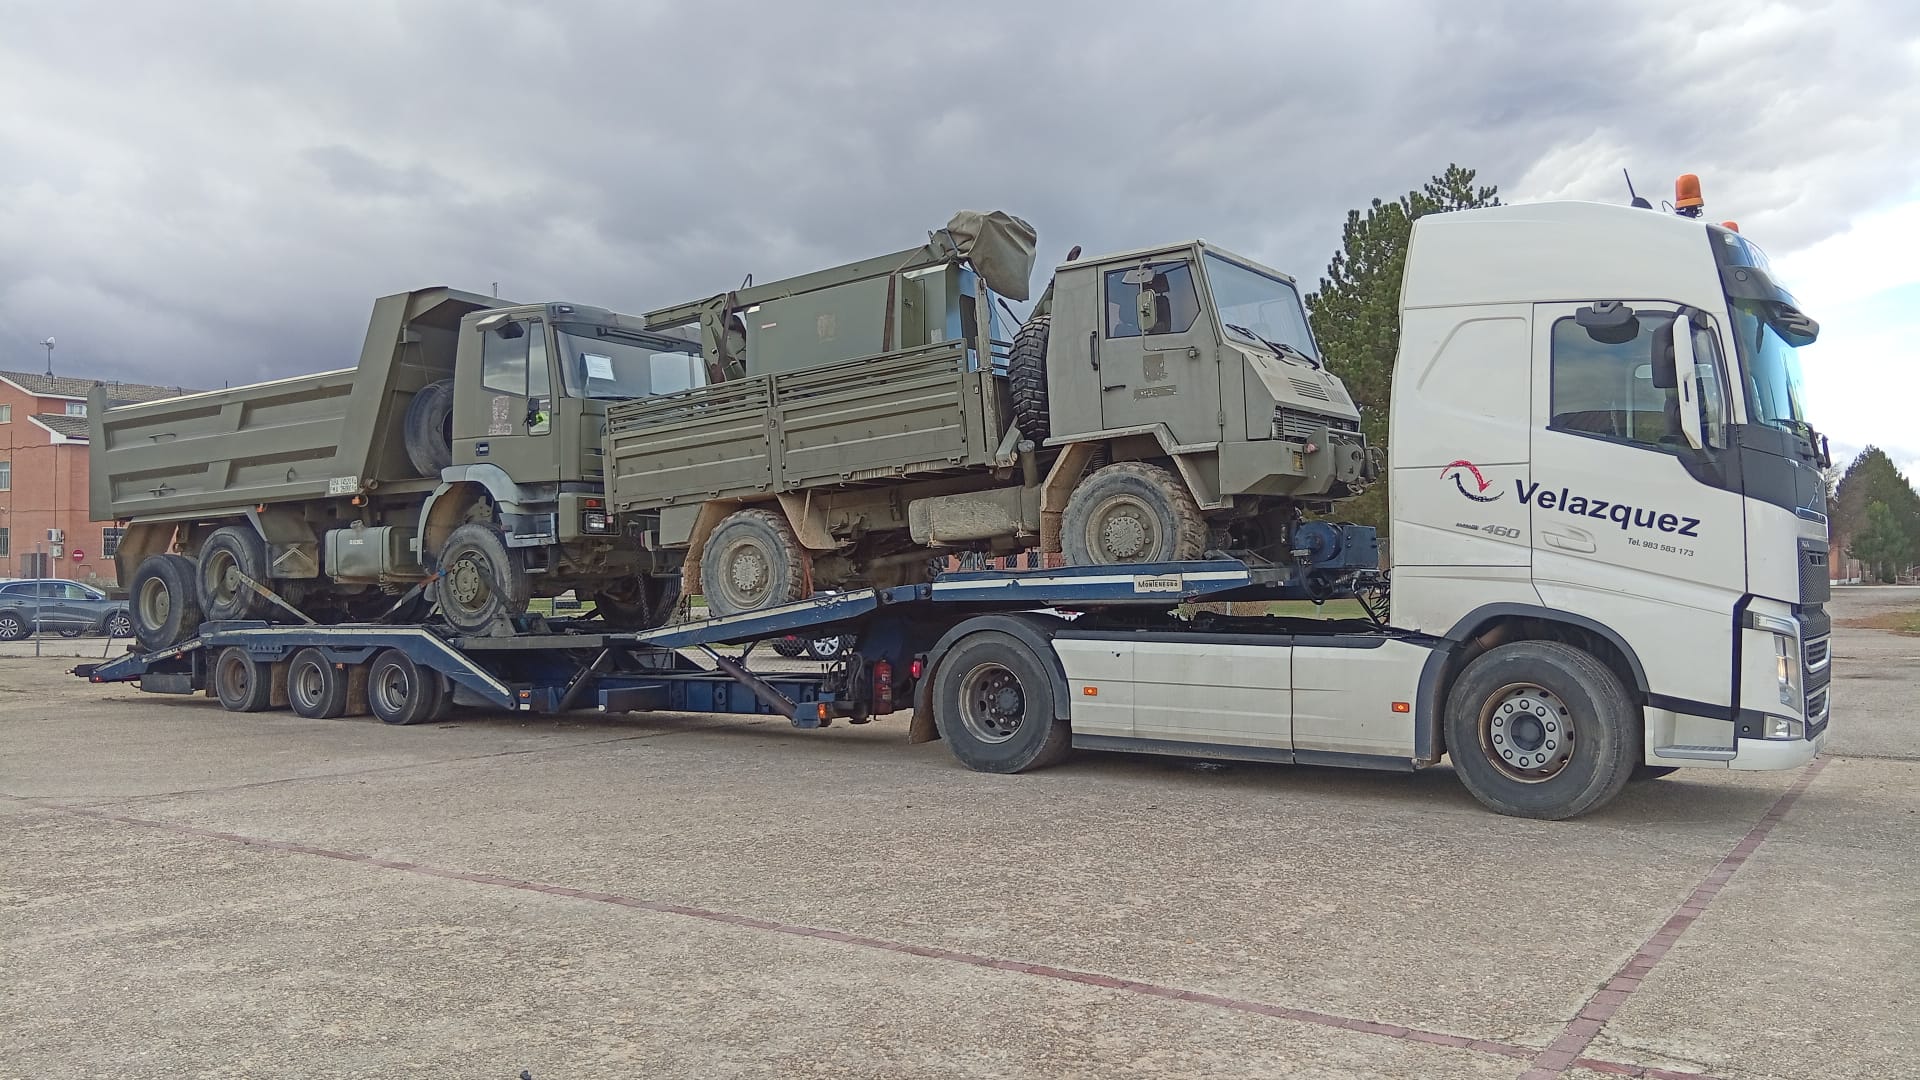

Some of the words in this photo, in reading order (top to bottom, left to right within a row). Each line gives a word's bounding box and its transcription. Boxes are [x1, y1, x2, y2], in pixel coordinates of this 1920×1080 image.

[1515, 479, 1700, 537] Velazquez
[1482, 525, 1520, 538] 460
[1628, 537, 1641, 546] Tel.
[1679, 548, 1694, 557] 173
